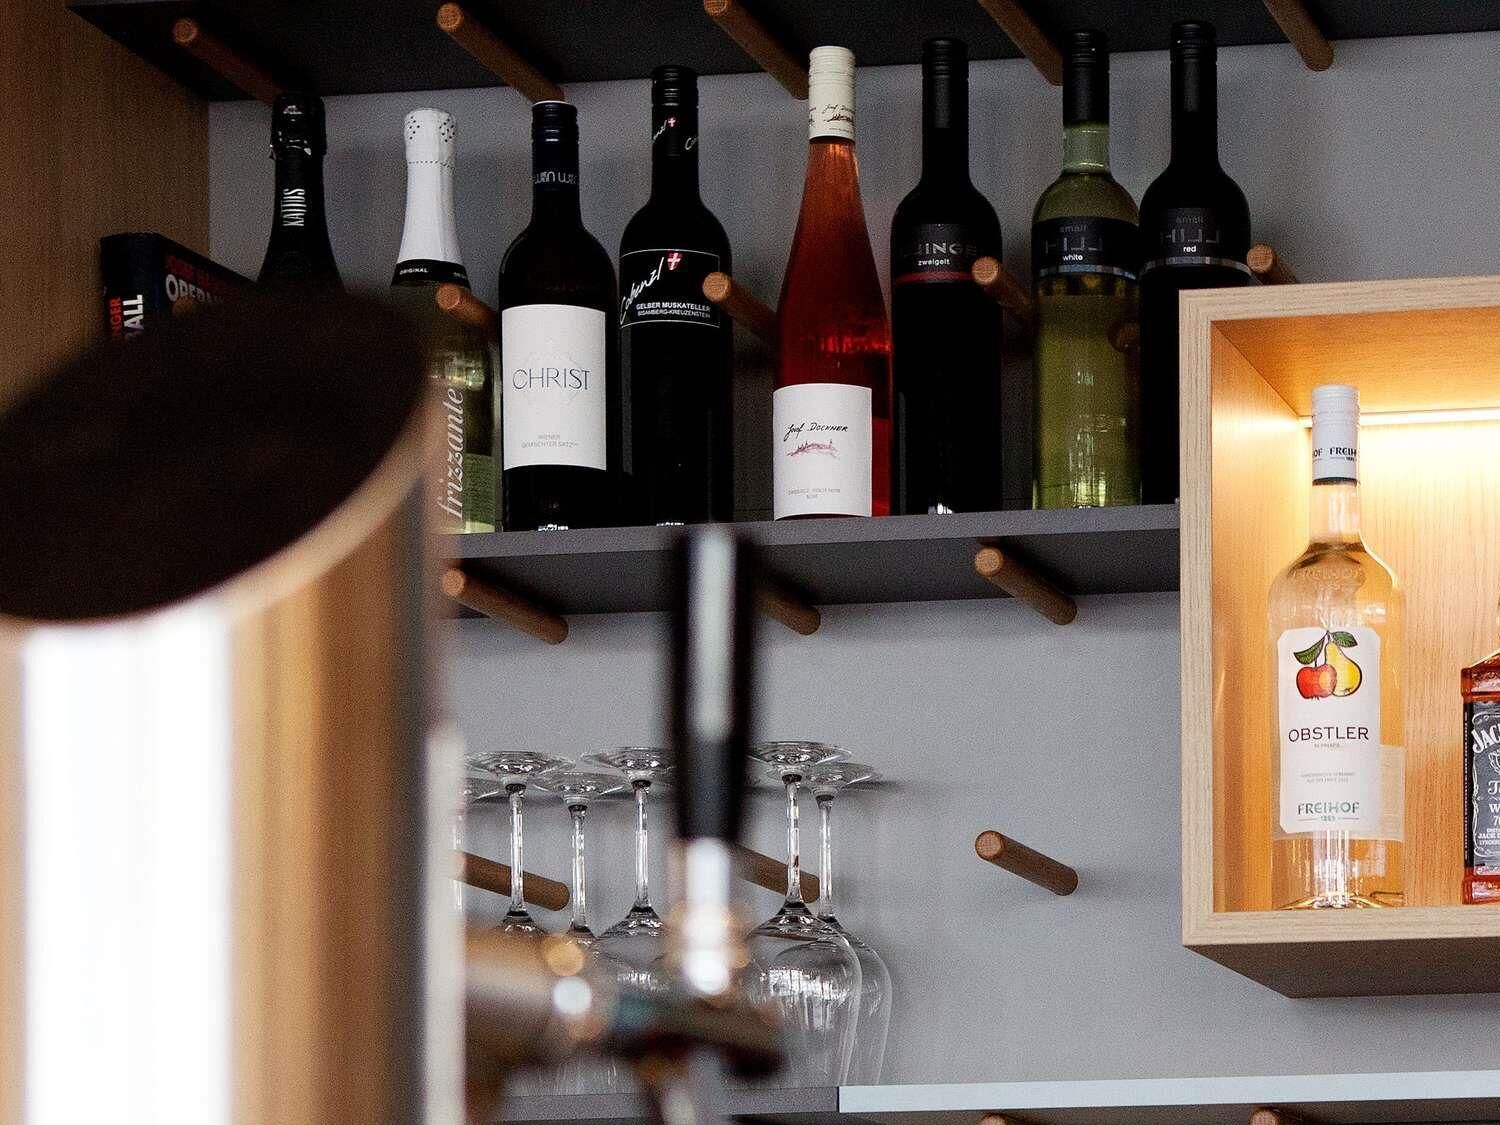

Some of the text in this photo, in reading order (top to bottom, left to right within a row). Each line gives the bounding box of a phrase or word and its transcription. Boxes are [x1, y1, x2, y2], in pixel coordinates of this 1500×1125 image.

[1183, 245, 1197, 254] red
[1062, 253, 1084, 262] white
[636, 301, 711, 312] GELBER MUSKATELLER
[512, 367, 592, 391] CHRIST
[438, 388, 464, 520] frizzante
[1288, 726, 1370, 743] OBSTLER
[1297, 801, 1360, 815] FREIHOF
